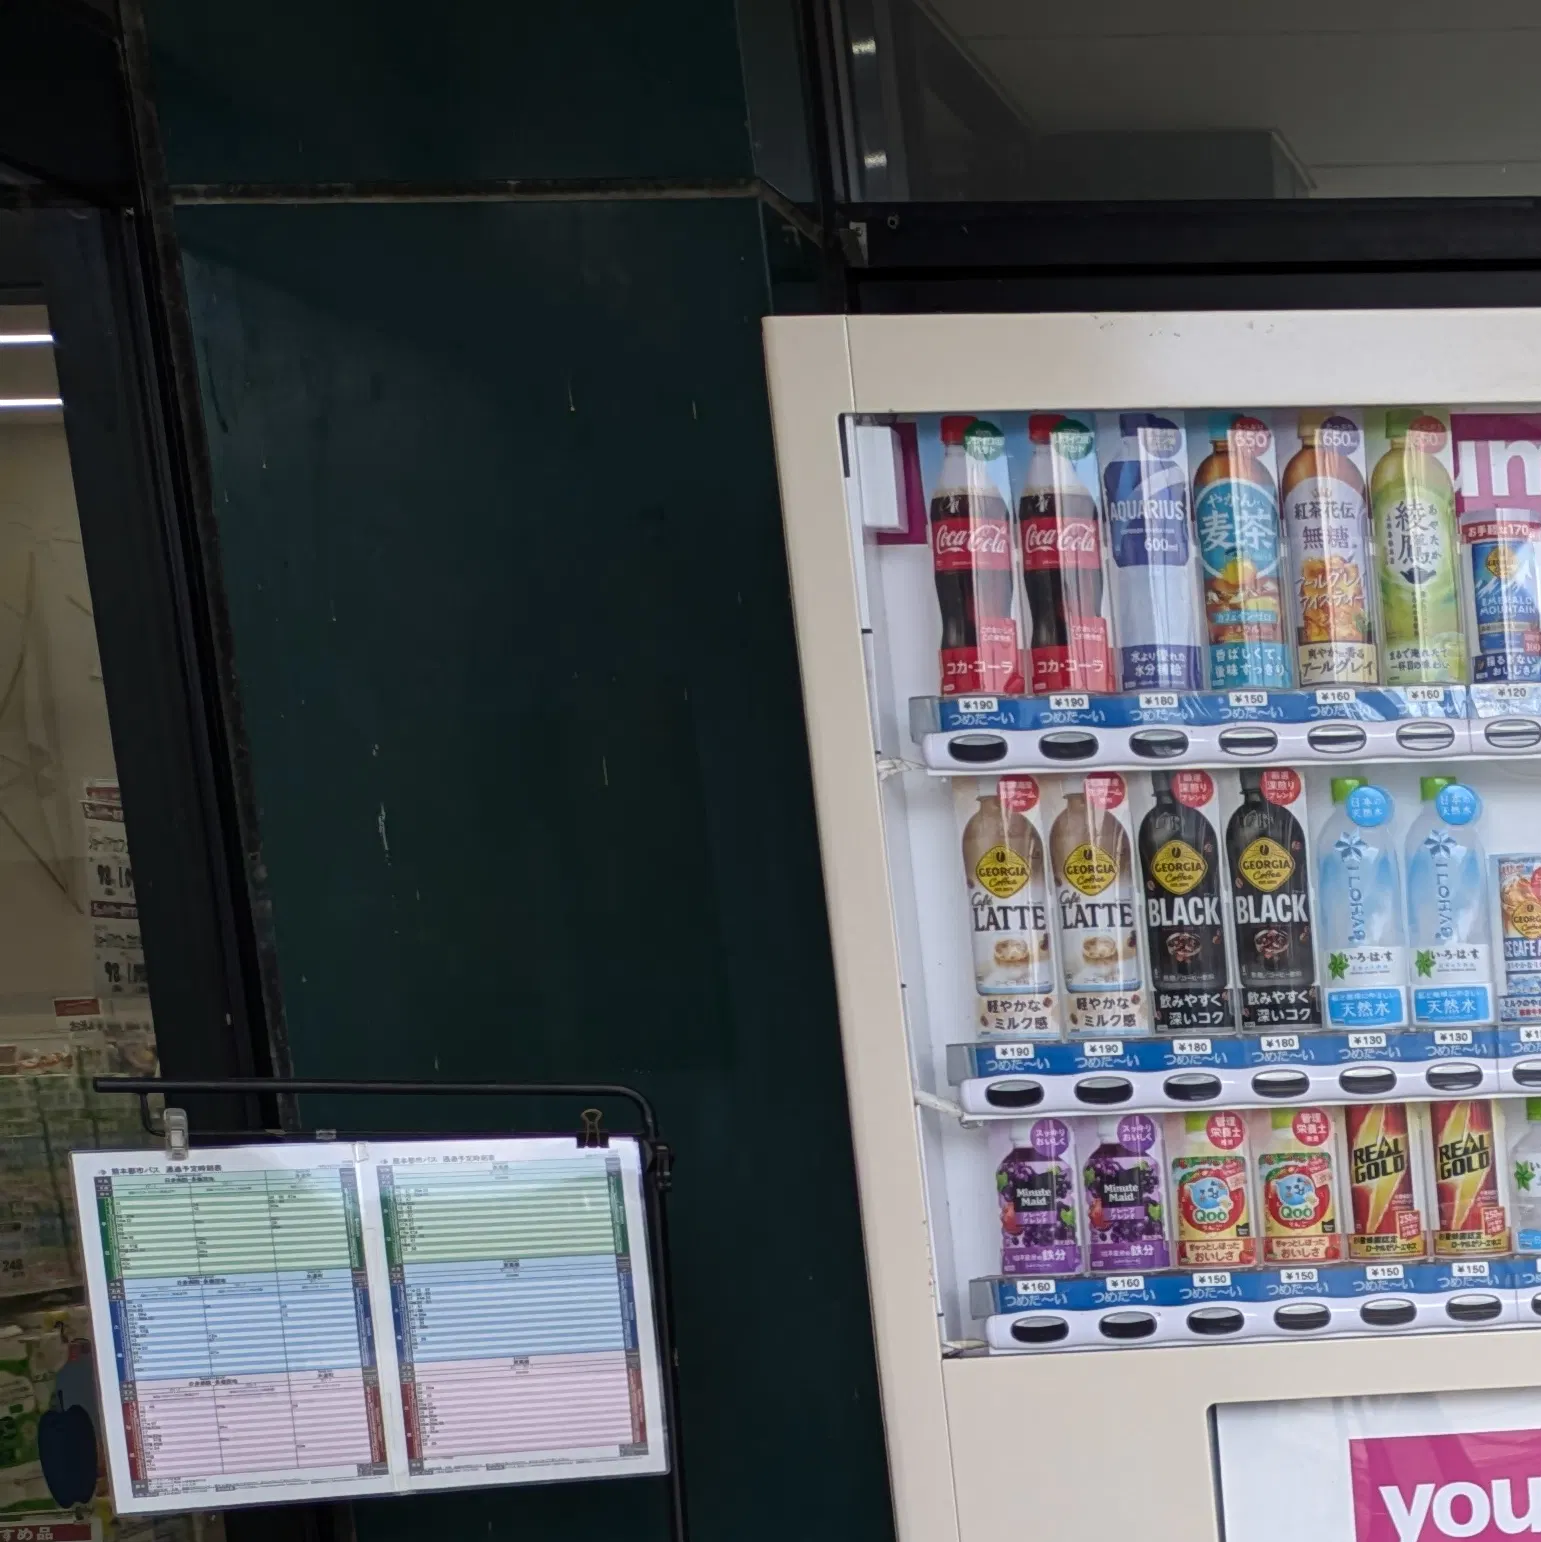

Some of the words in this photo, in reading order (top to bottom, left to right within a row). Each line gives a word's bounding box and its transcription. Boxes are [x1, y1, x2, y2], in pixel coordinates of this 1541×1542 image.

[1109, 499, 1186, 522] AQUARIUS
[1293, 501, 1356, 521] 紅茶花伝
[1201, 509, 1275, 552] 麦茶
[935, 523, 1007, 555] Coca-Cola
[1302, 526, 1350, 551] 無糖
[945, 659, 1014, 675] コカ・コーラ
[1036, 658, 1105, 674] コカ・コーラ
[1133, 662, 1182, 678] 水分補給
[1301, 656, 1376, 677] アールグレイ
[1054, 696, 1085, 708] ¥190
[1143, 694, 1175, 707] ¥180
[1234, 692, 1264, 705] ¥150
[1320, 690, 1351, 702] ¥160
[1410, 688, 1440, 701] ¥160
[962, 698, 994, 711] ¥190
[977, 865, 1028, 878] GEORGIA
[1065, 864, 1116, 877] GEORGIA
[1061, 902, 1134, 931] LATTE
[1148, 896, 1221, 928] BLACK
[1236, 893, 1309, 925] BLACK
[972, 905, 1047, 932] LATTE
[1076, 997, 1131, 1012] 軽やかな
[1158, 992, 1224, 1010] 飲みやすく
[1246, 989, 1310, 1006] 飲みやすく
[987, 999, 1042, 1014] 軽やかな
[1340, 1000, 1391, 1017] 天然水
[1426, 998, 1477, 1015] 天然水
[993, 1014, 1049, 1030] ミルク感
[1083, 1012, 1137, 1028] ミルク感
[1168, 1010, 1226, 1027] 深いコク
[1256, 1007, 1312, 1023] 深いコク
[1266, 1037, 1296, 1049] ¥180
[1352, 1034, 1384, 1047] ¥130
[1438, 1031, 1470, 1044] ¥130
[1000, 1045, 1030, 1058] ¥190
[1089, 1042, 1119, 1055] ¥190
[1178, 1040, 1208, 1053] ¥180
[1353, 1135, 1403, 1165] REAL
[1438, 1132, 1490, 1163] REAL
[1354, 1154, 1406, 1184] GOLD
[1440, 1151, 1491, 1181] GOLD
[1016, 1187, 1052, 1198] Minute
[1103, 1183, 1139, 1194] Minute
[1019, 1195, 1049, 1207] Maid
[1108, 1191, 1136, 1203] Maid
[1194, 1208, 1229, 1224] Qoo
[1280, 1204, 1314, 1221] Qoo
[1194, 1249, 1235, 1262] おいしさ
[1281, 1246, 1321, 1260] おいしさ
[1284, 1269, 1316, 1282] ¥150
[1370, 1265, 1401, 1278] ¥150
[1456, 1262, 1487, 1276] ¥150
[1109, 1276, 1141, 1289] ¥160
[1196, 1272, 1228, 1285] ¥150
[1020, 1280, 1051, 1293] ¥160
